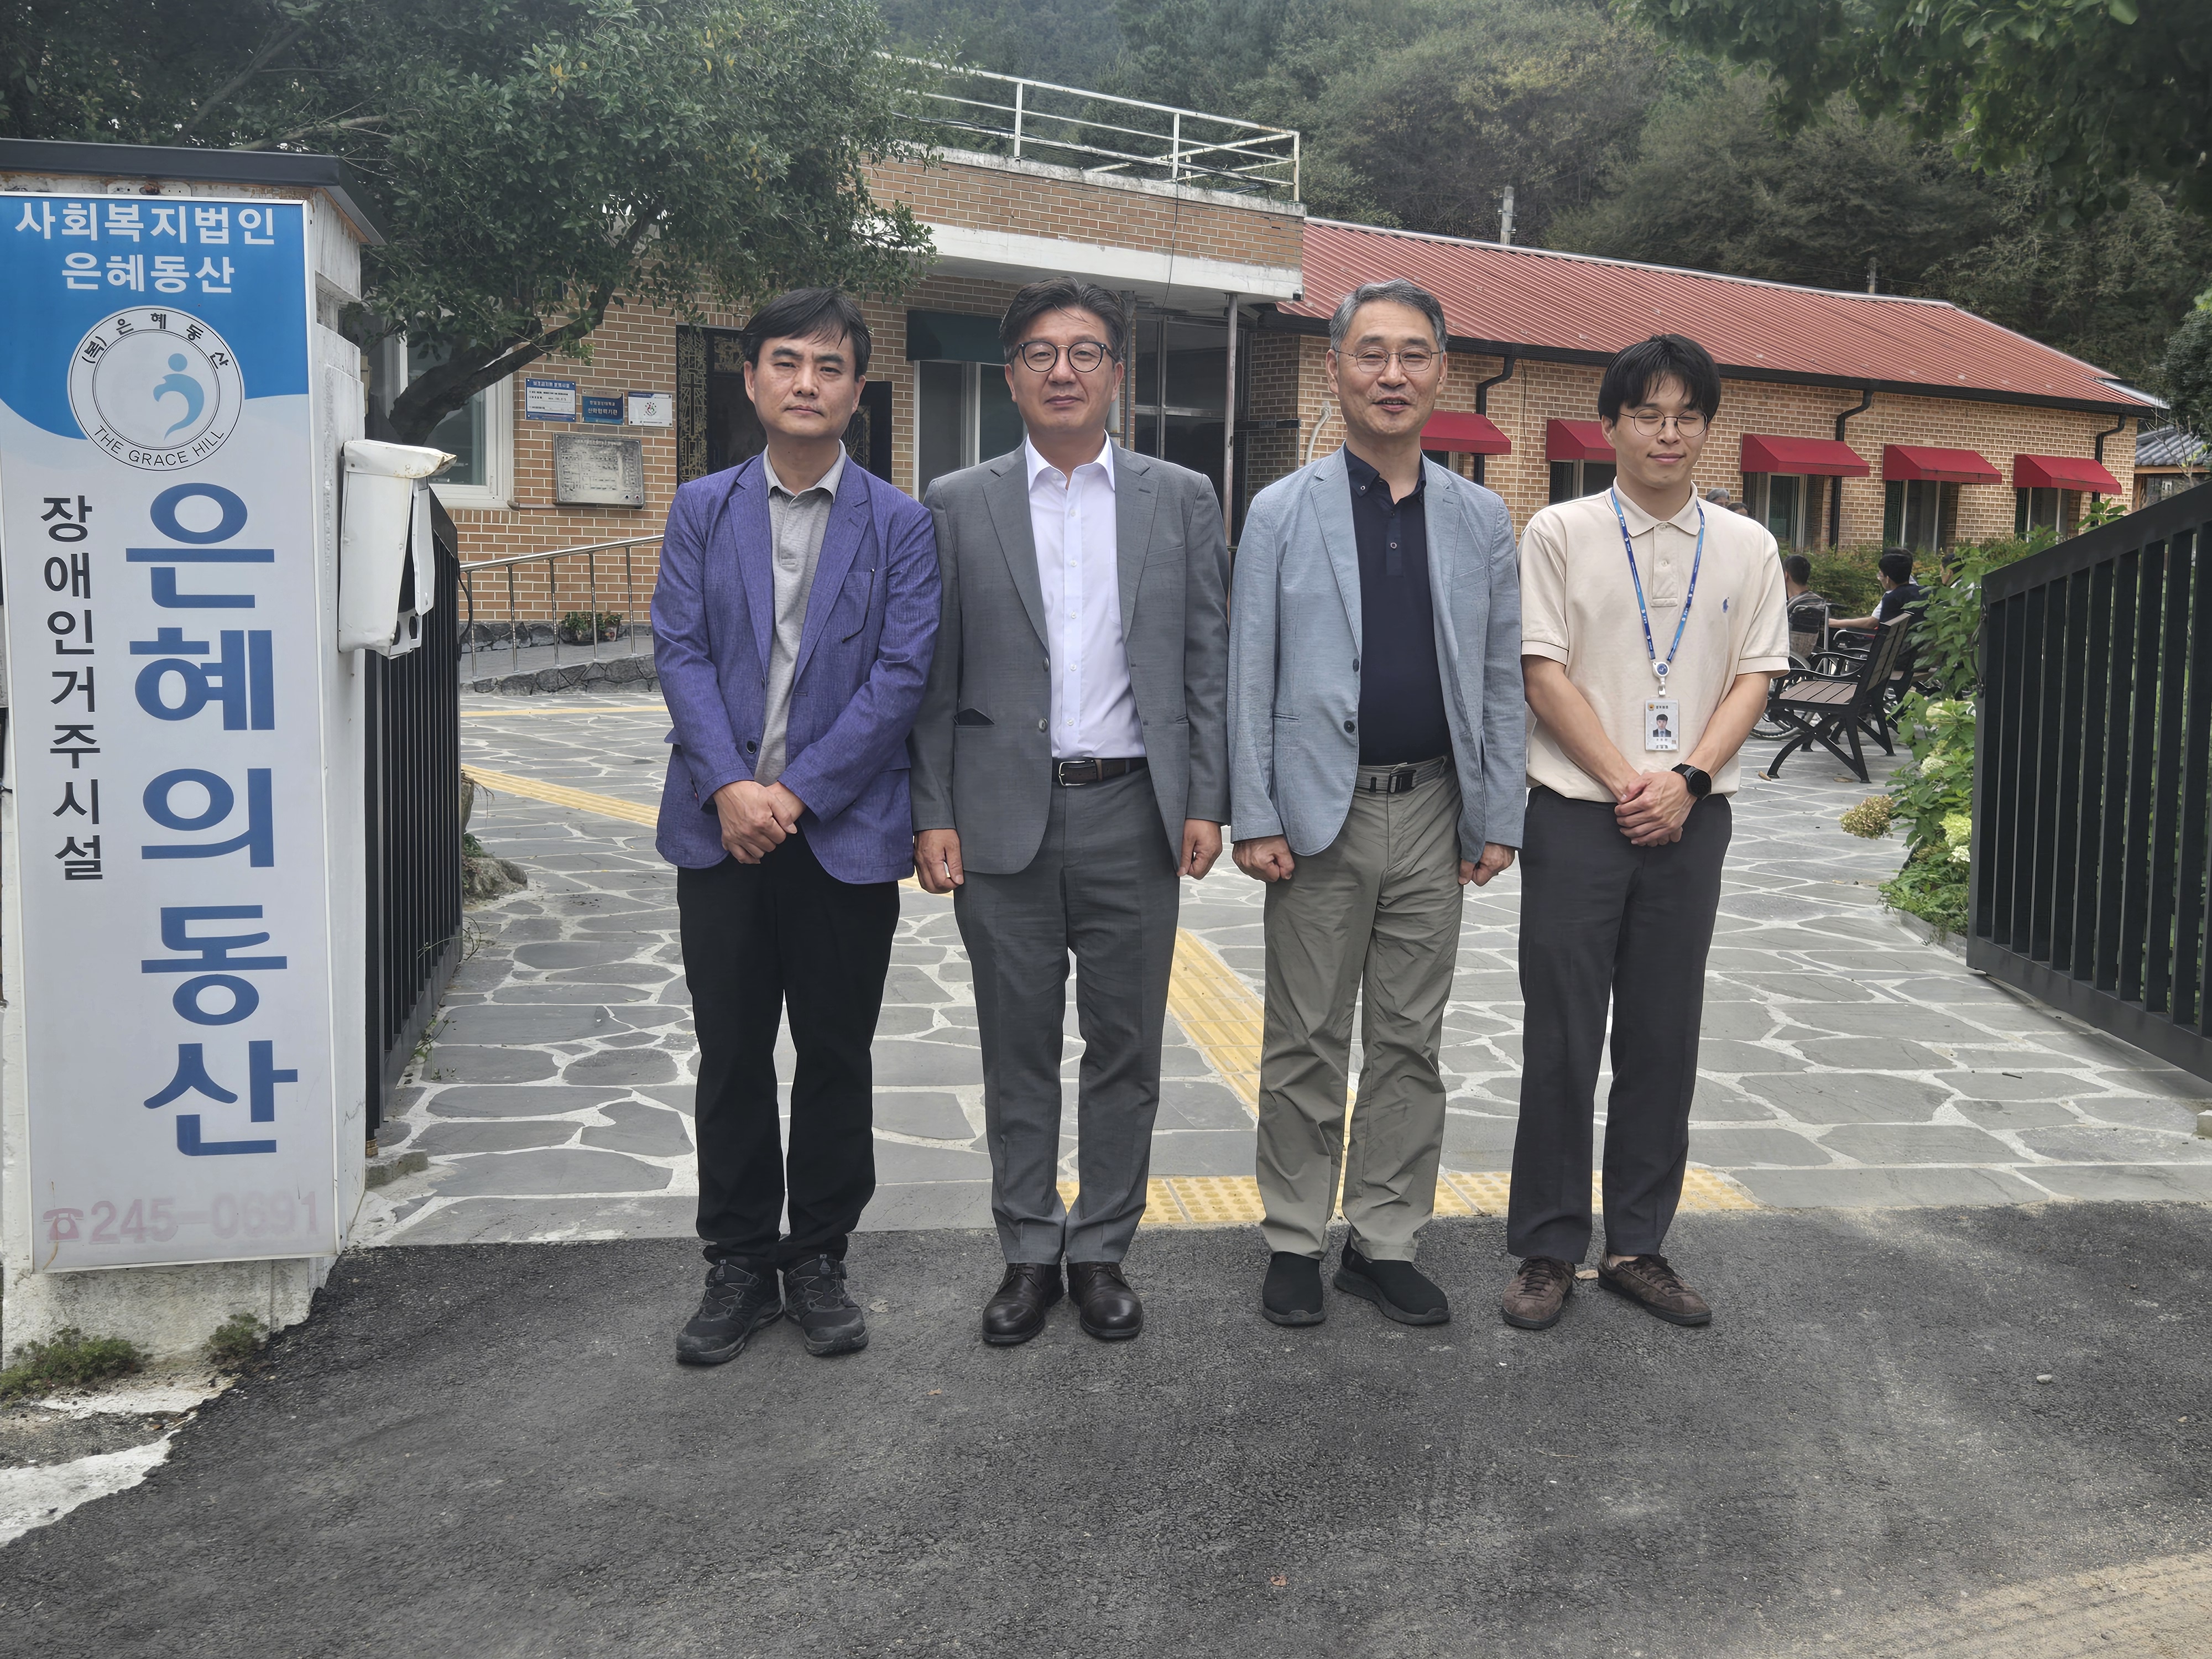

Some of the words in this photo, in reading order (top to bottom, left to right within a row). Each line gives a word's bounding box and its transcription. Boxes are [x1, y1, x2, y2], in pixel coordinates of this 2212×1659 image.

[15, 201, 275, 244] 사회복지법인
[61, 252, 234, 293] 은혜동산
[94, 425, 124, 455] THE
[128, 450, 189, 466] GRACE
[192, 431, 225, 457] HILL
[40, 495, 103, 880] 장애인거주시설
